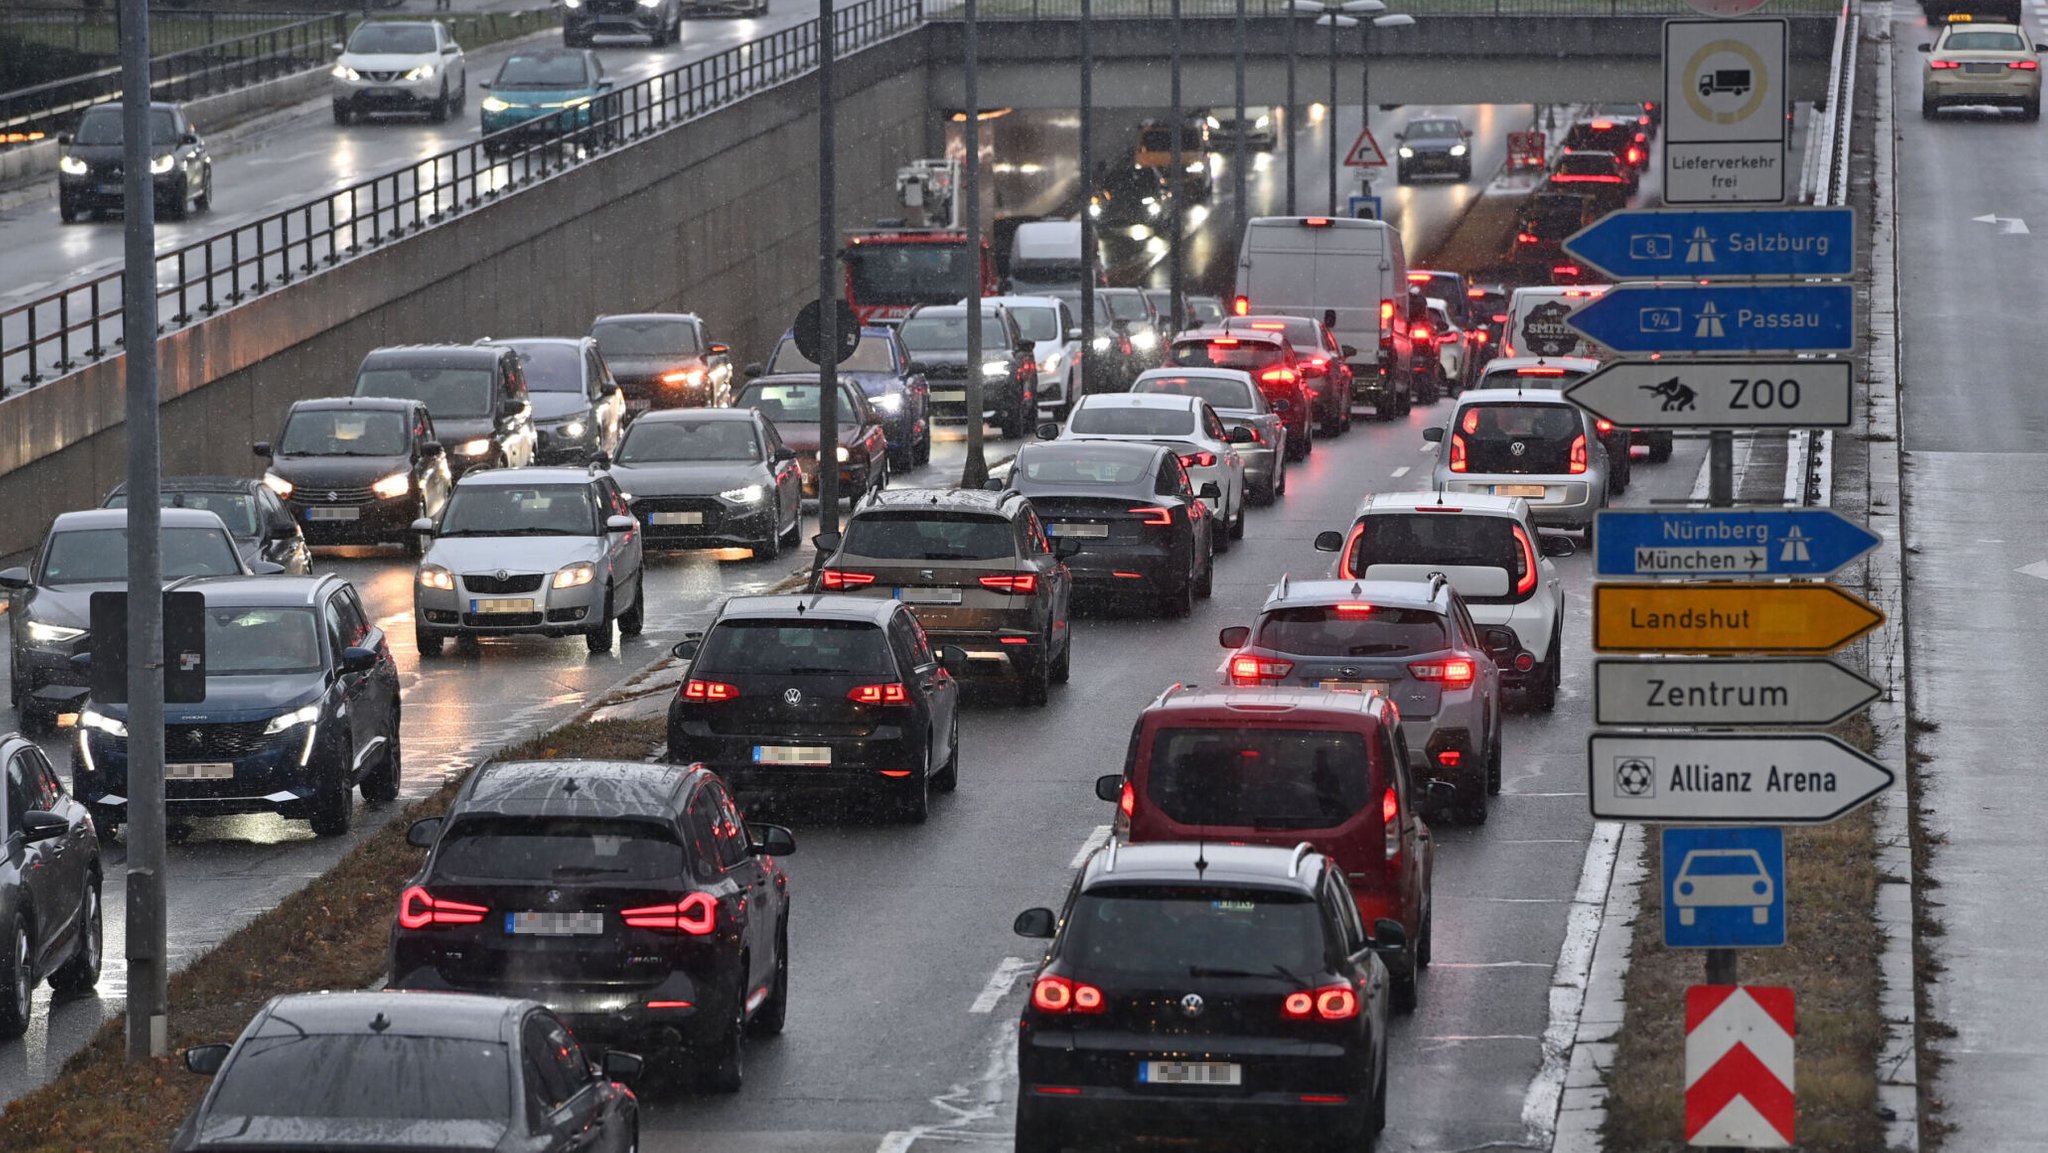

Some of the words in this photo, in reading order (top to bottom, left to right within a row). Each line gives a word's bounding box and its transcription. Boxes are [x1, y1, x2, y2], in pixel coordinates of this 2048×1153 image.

[1673, 155, 1776, 170] Lieferverkehr
[1711, 175, 1738, 188] frei
[1646, 239, 1657, 254] 8
[1729, 233, 1829, 256] Salzburg
[1651, 312, 1670, 328] 94
[1738, 309, 1819, 329] Passau
[1729, 379, 1801, 410] ZOO
[1664, 521, 1769, 544] Nürnberg
[1638, 551, 1736, 570] München
[1631, 608, 1750, 630] Landshut
[1647, 680, 1788, 707] Zentrum
[1670, 765, 1752, 793] Allianz
[1767, 765, 1837, 793] Arena
